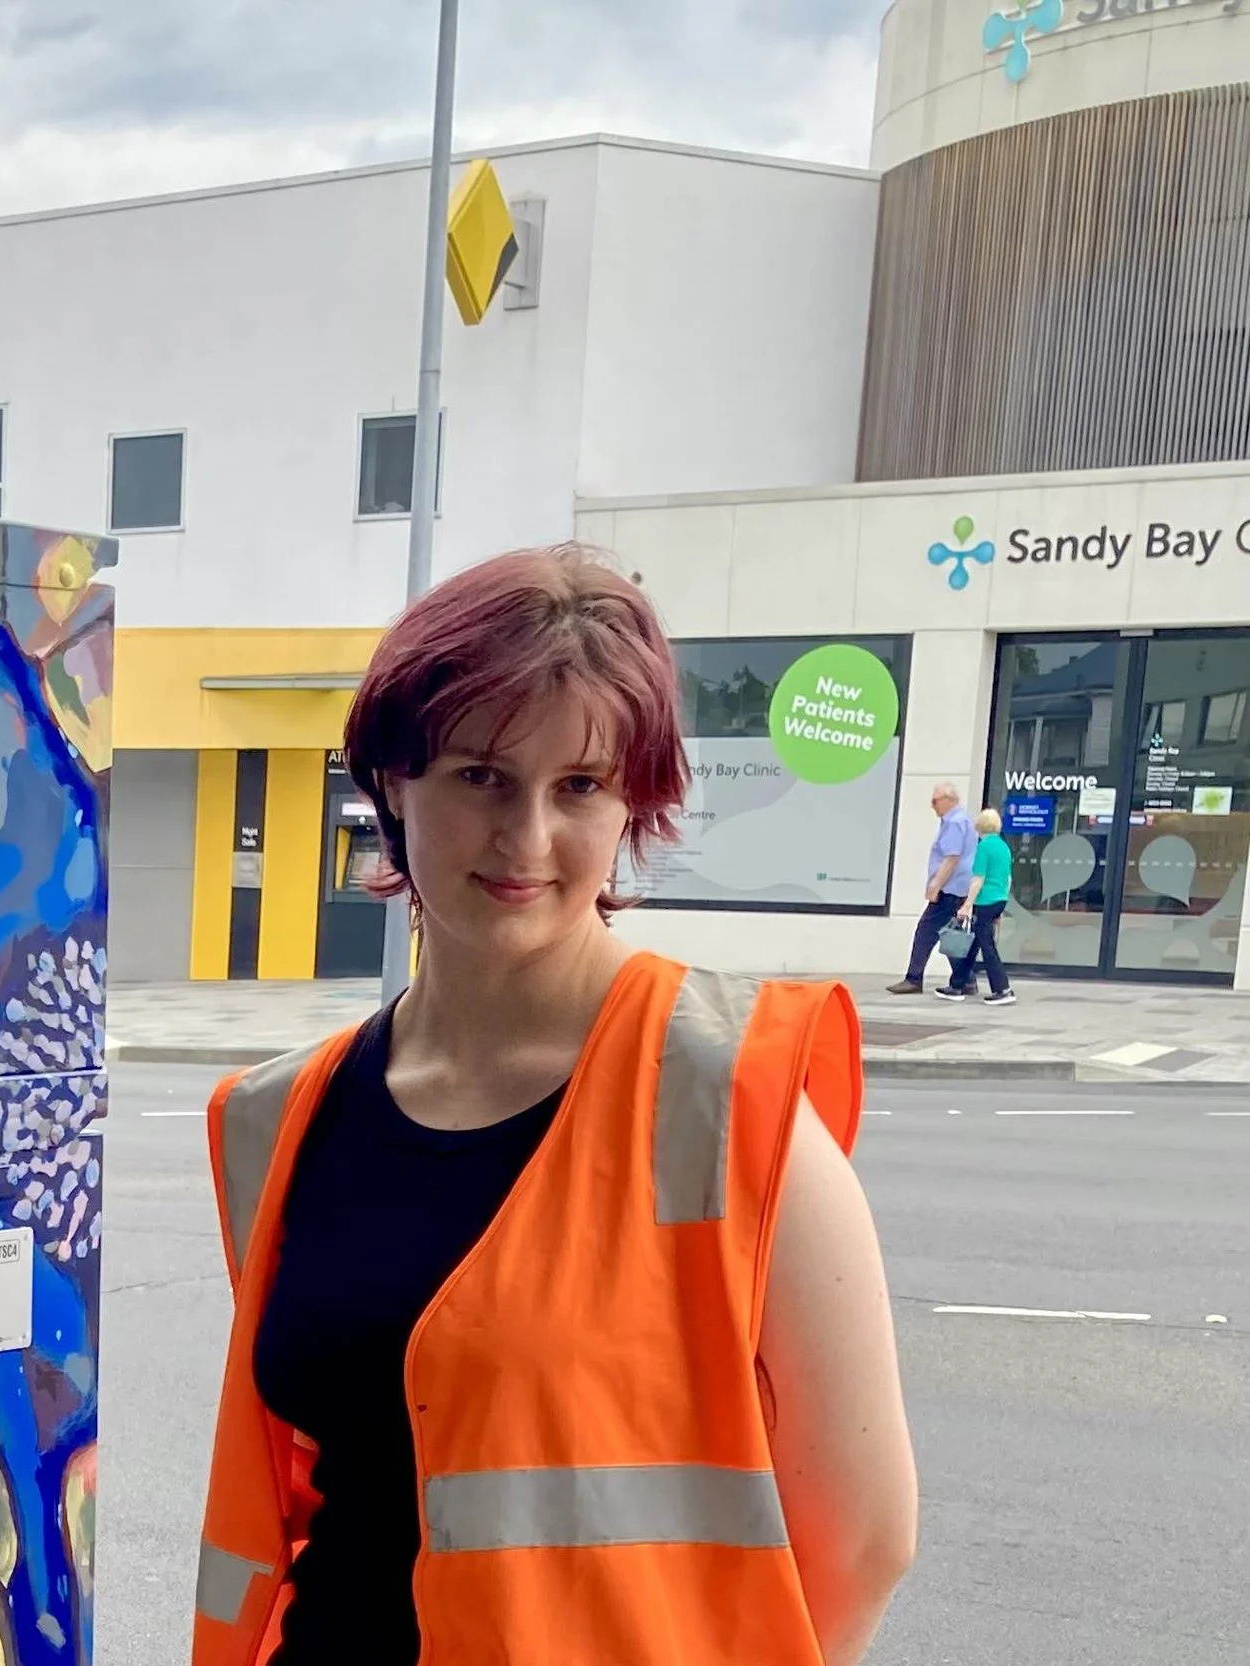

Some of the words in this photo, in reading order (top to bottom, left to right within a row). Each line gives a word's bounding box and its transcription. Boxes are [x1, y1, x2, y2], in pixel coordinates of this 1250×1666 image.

[1006, 524, 1132, 569] Sandy
[1146, 522, 1222, 566] Bay
[816, 675, 862, 701] New
[791, 694, 876, 728] Patients
[784, 716, 874, 752] Welcome
[691, 763, 712, 779] ndy
[716, 763, 740, 780] Bay
[743, 762, 781, 777] Clinic
[1004, 771, 1098, 791] Welcome
[681, 809, 716, 821] Centre
